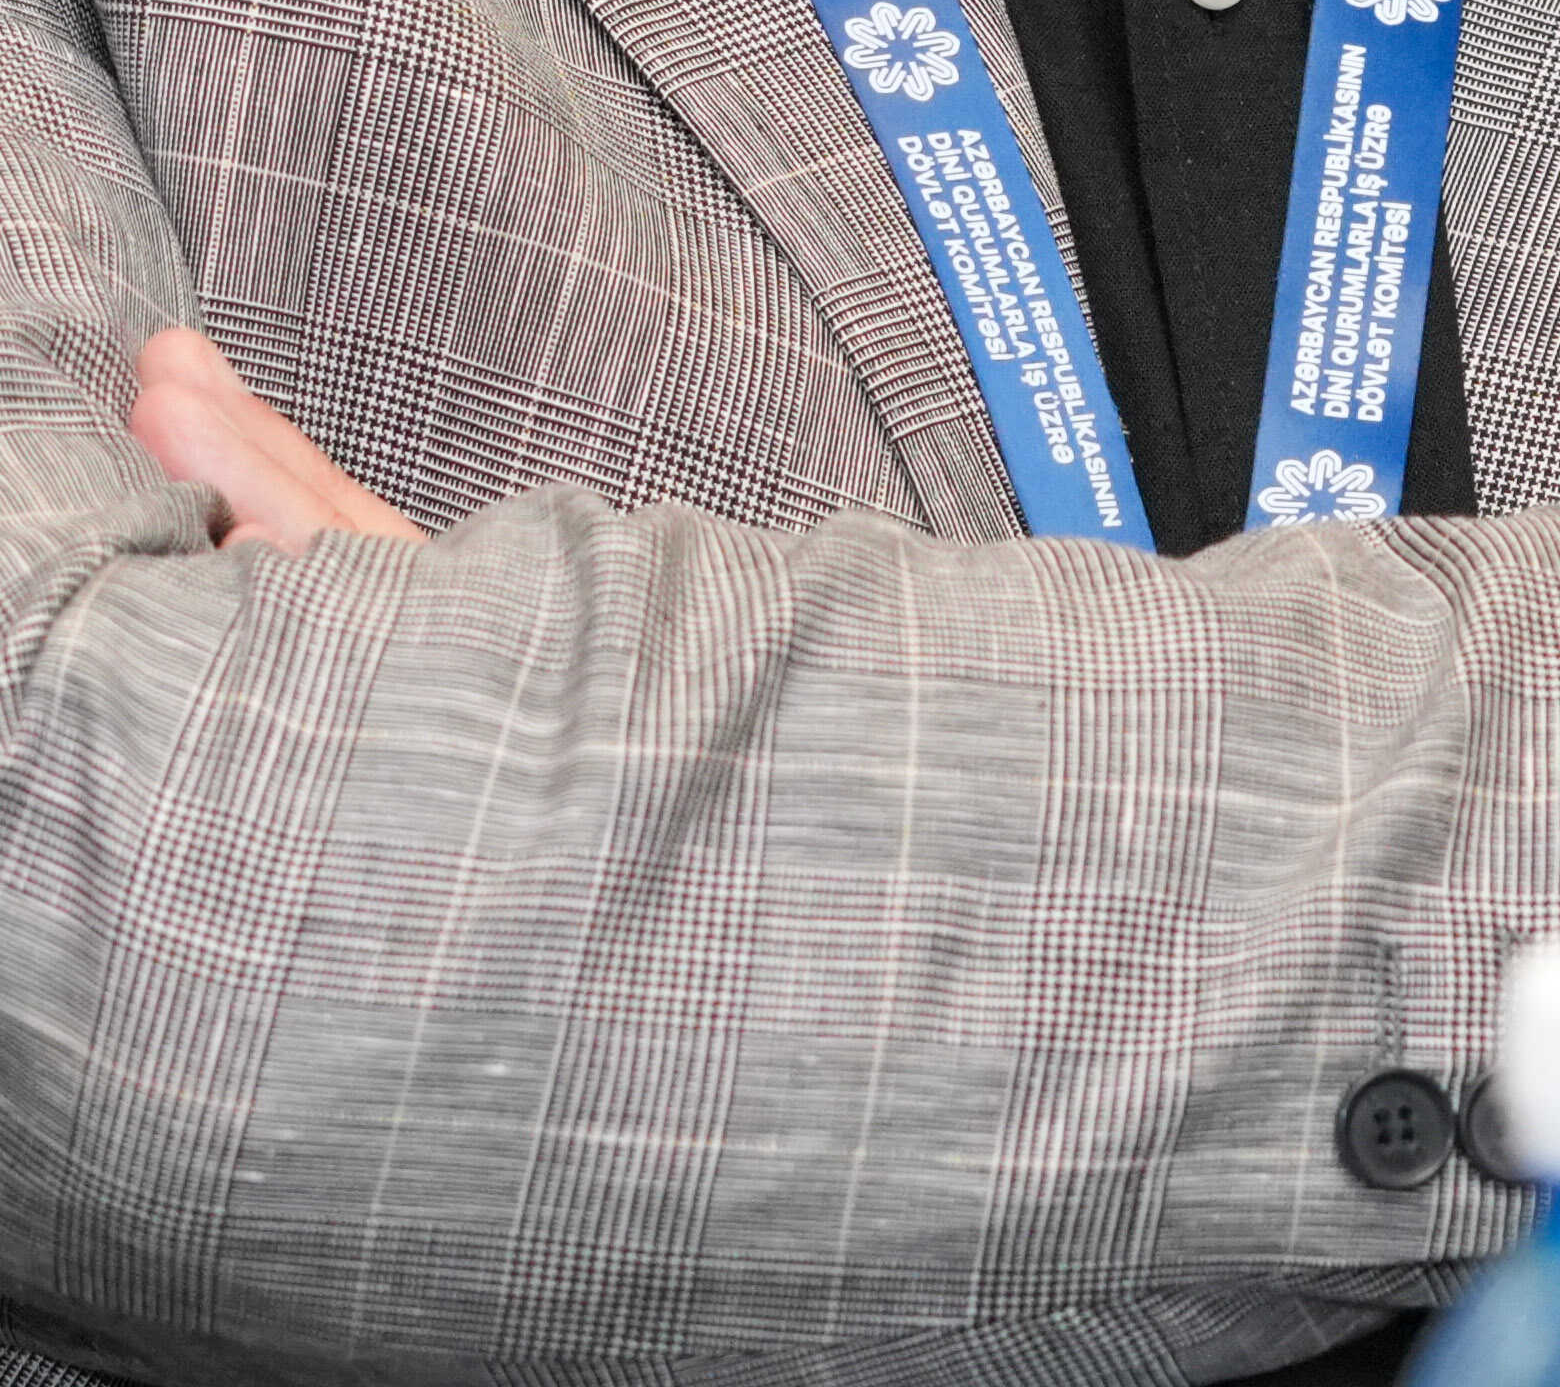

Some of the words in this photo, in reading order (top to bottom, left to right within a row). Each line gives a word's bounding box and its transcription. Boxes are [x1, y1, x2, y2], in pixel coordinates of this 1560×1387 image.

[1349, 173, 1388, 197] İŞ
[1355, 105, 1392, 171] ÜZRƏ
[898, 136, 960, 234] DÖVLƏT
[944, 239, 1015, 360] KOMİTƏSİ
[927, 132, 972, 180] DİNİ
[952, 185, 1036, 358] QURUMLARLA
[1021, 362, 1047, 386] İŞ
[1034, 392, 1074, 464] ÜZRƏ
[1291, 251, 1336, 415] AZƏRBAYCAN
[1314, 44, 1366, 247] RESPUBLİKASININ
[1331, 201, 1378, 366] QURUMLARLA
[1371, 202, 1411, 319] KOMİTƏSİ
[957, 130, 1044, 296] AZƏRBAYCAN
[1028, 300, 1122, 527] RESPUBLİKASININ
[1320, 369, 1354, 418] DİNİ
[1356, 322, 1394, 421] DÖVLƏT
